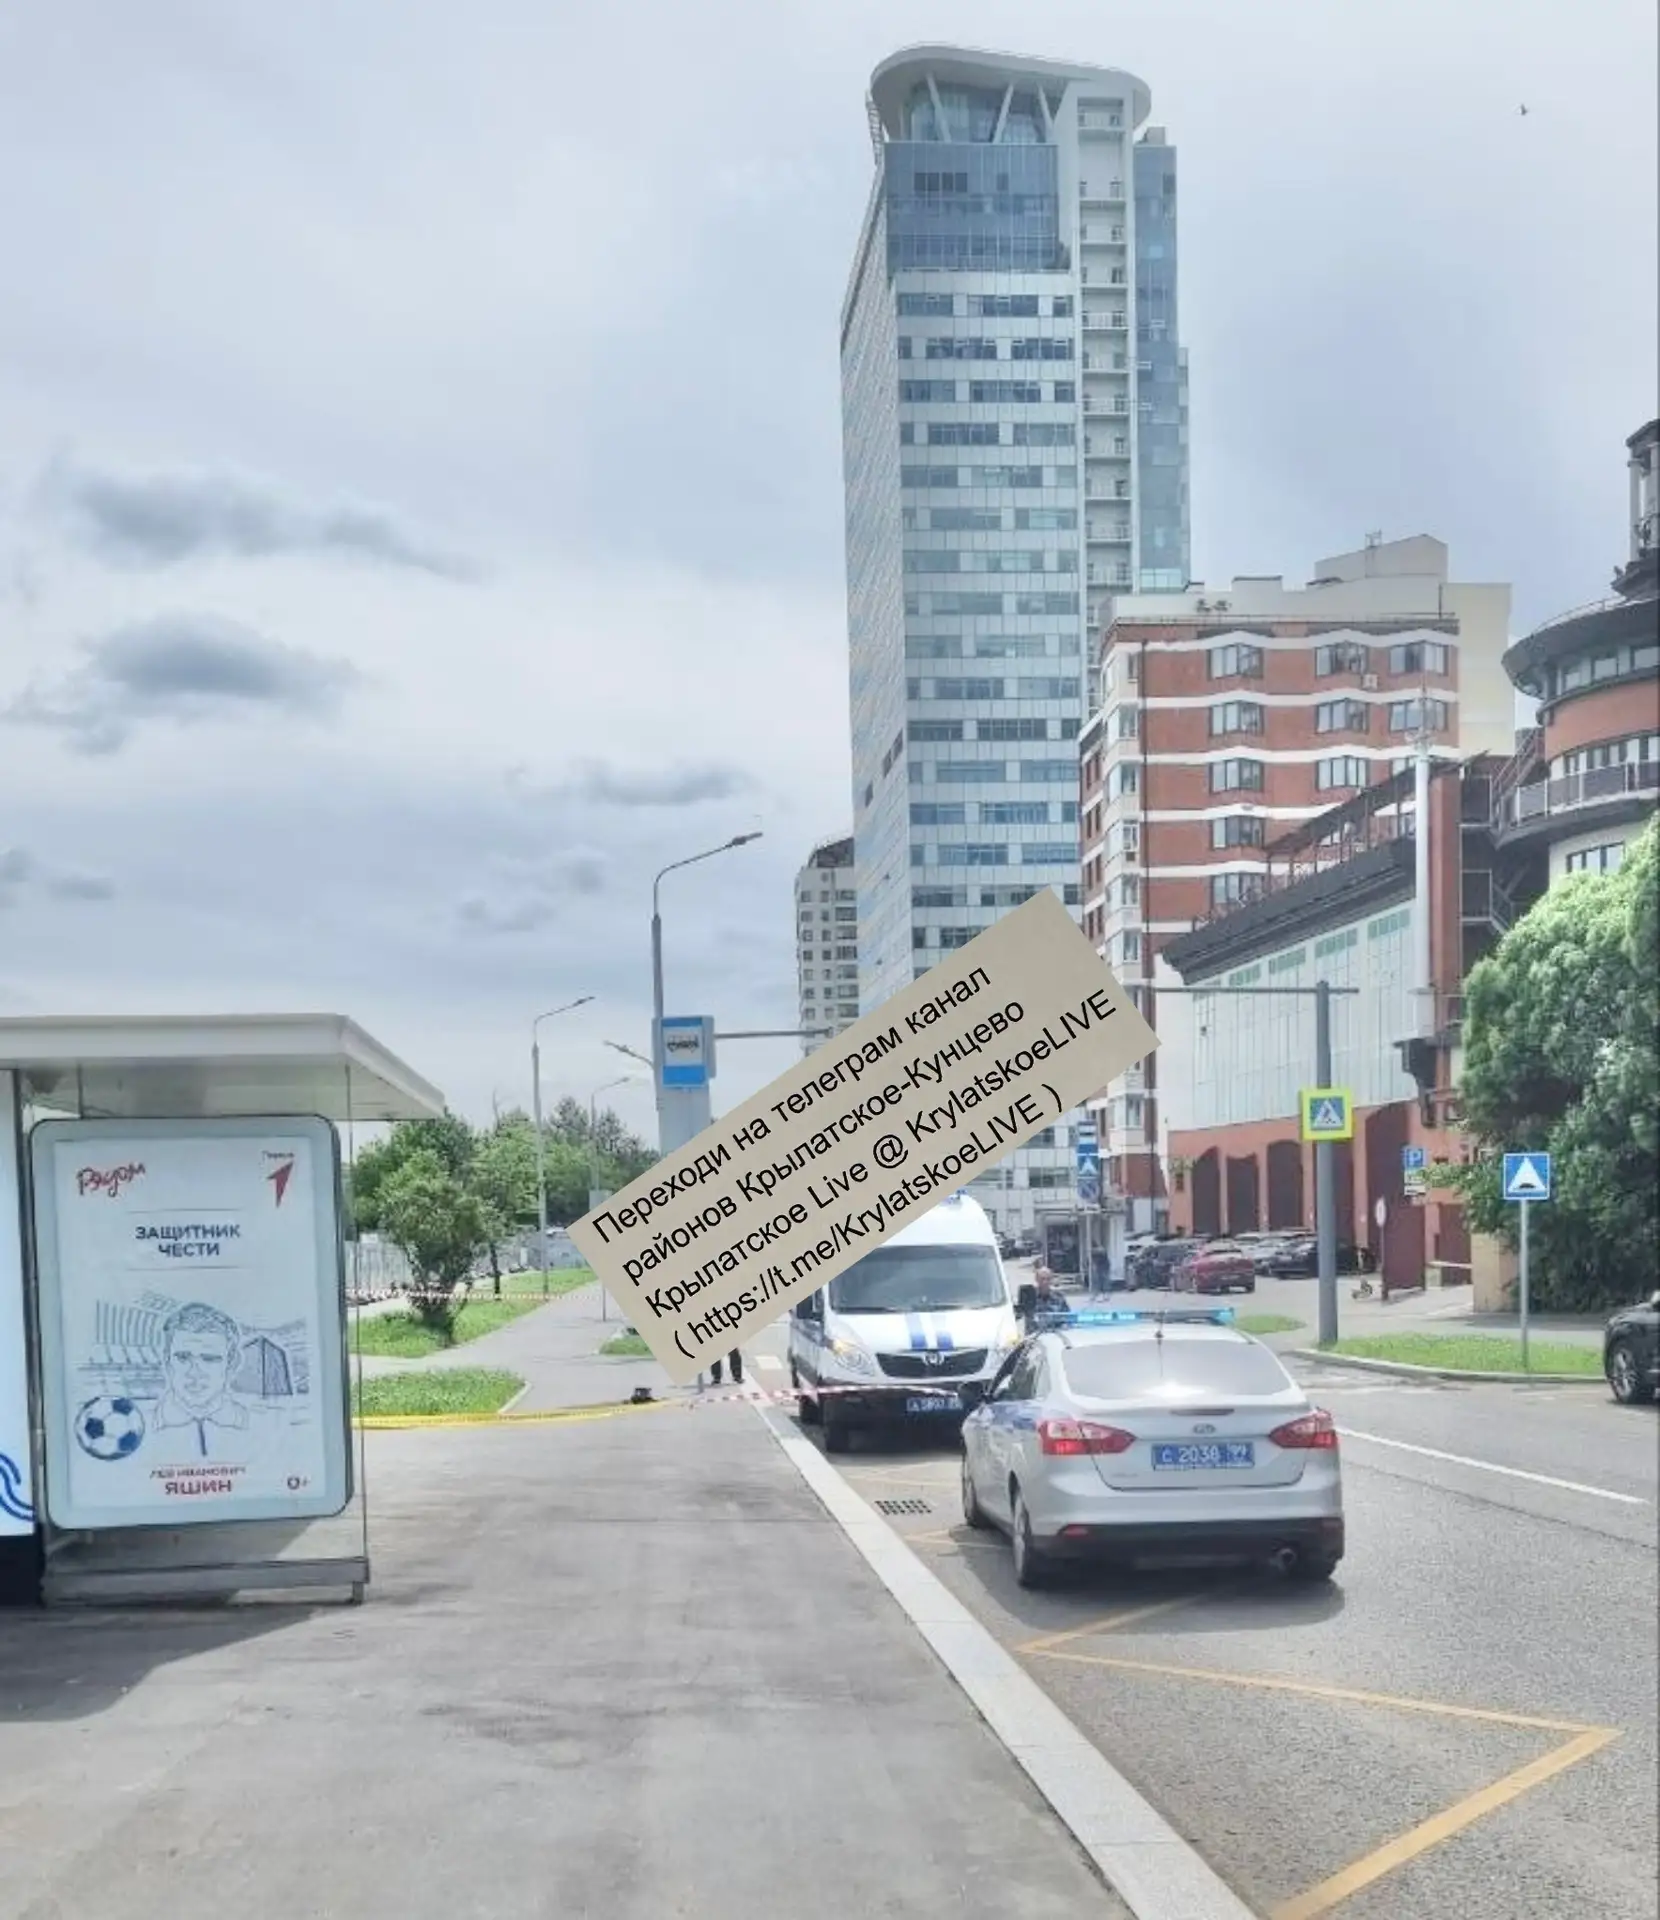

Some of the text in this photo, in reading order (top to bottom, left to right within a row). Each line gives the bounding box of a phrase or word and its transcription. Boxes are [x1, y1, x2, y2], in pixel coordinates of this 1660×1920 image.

[135, 1223, 241, 1242] ЗАЩИТНИК
[158, 1242, 220, 1257] ЧЕСТИ
[165, 1480, 232, 1496] ЯШИН
